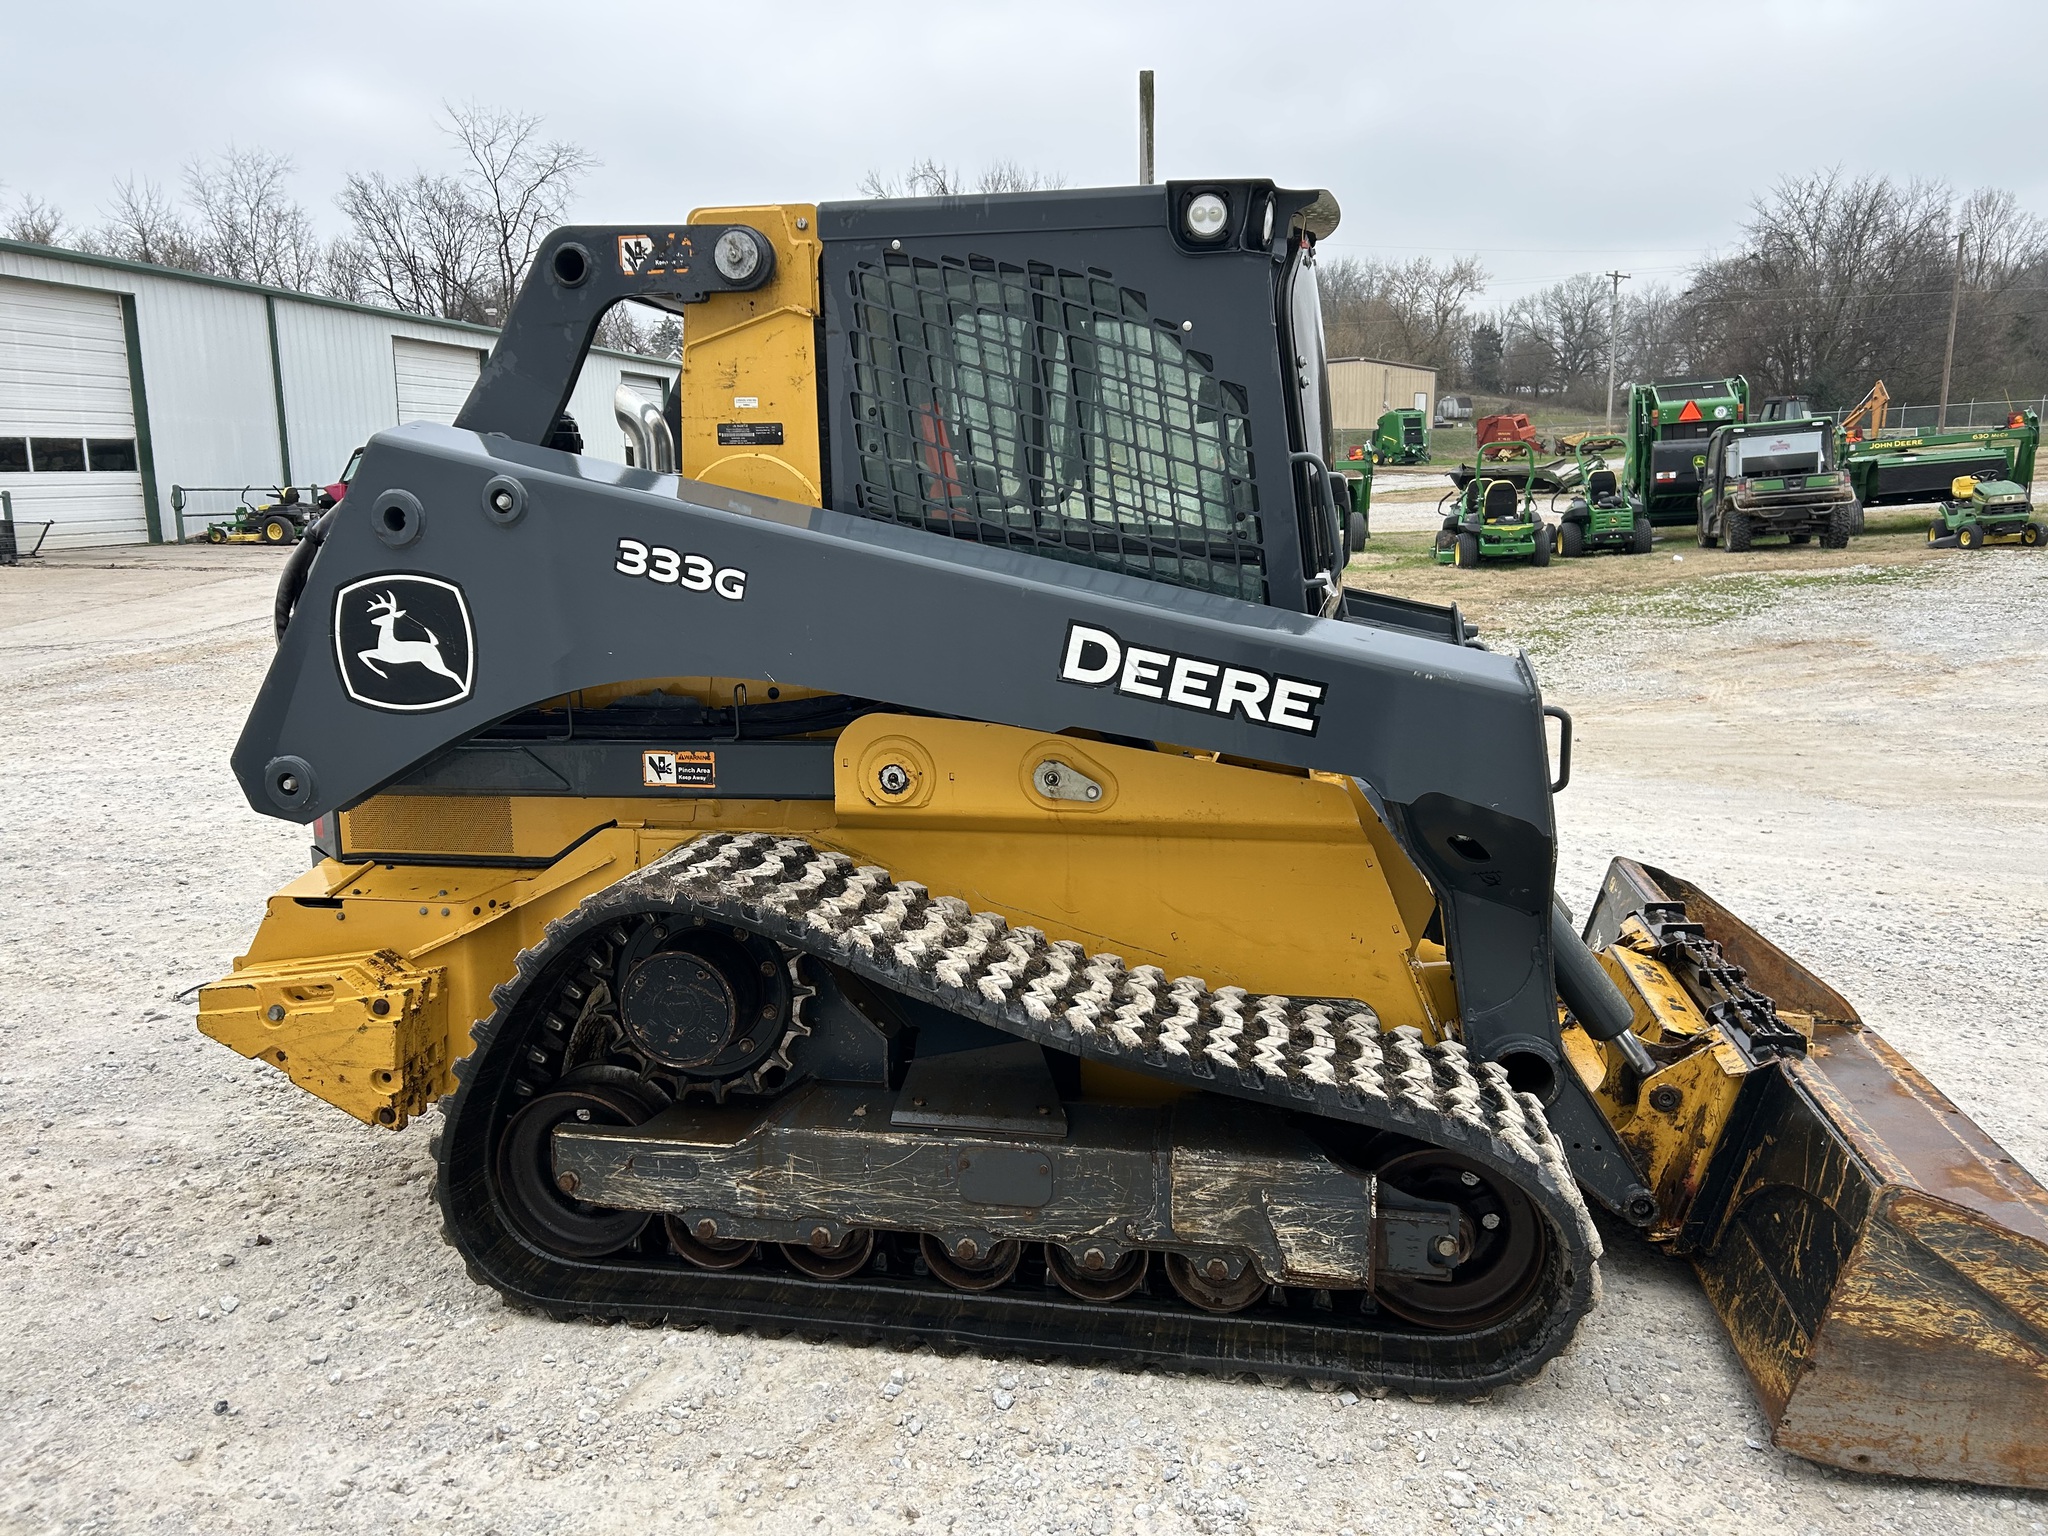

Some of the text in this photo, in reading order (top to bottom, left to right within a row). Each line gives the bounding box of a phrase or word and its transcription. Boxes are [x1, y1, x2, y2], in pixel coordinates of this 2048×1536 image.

[1894, 439, 1923, 447] DEERE
[615, 538, 747, 600] 333G
[1061, 623, 1322, 731] DEERE
